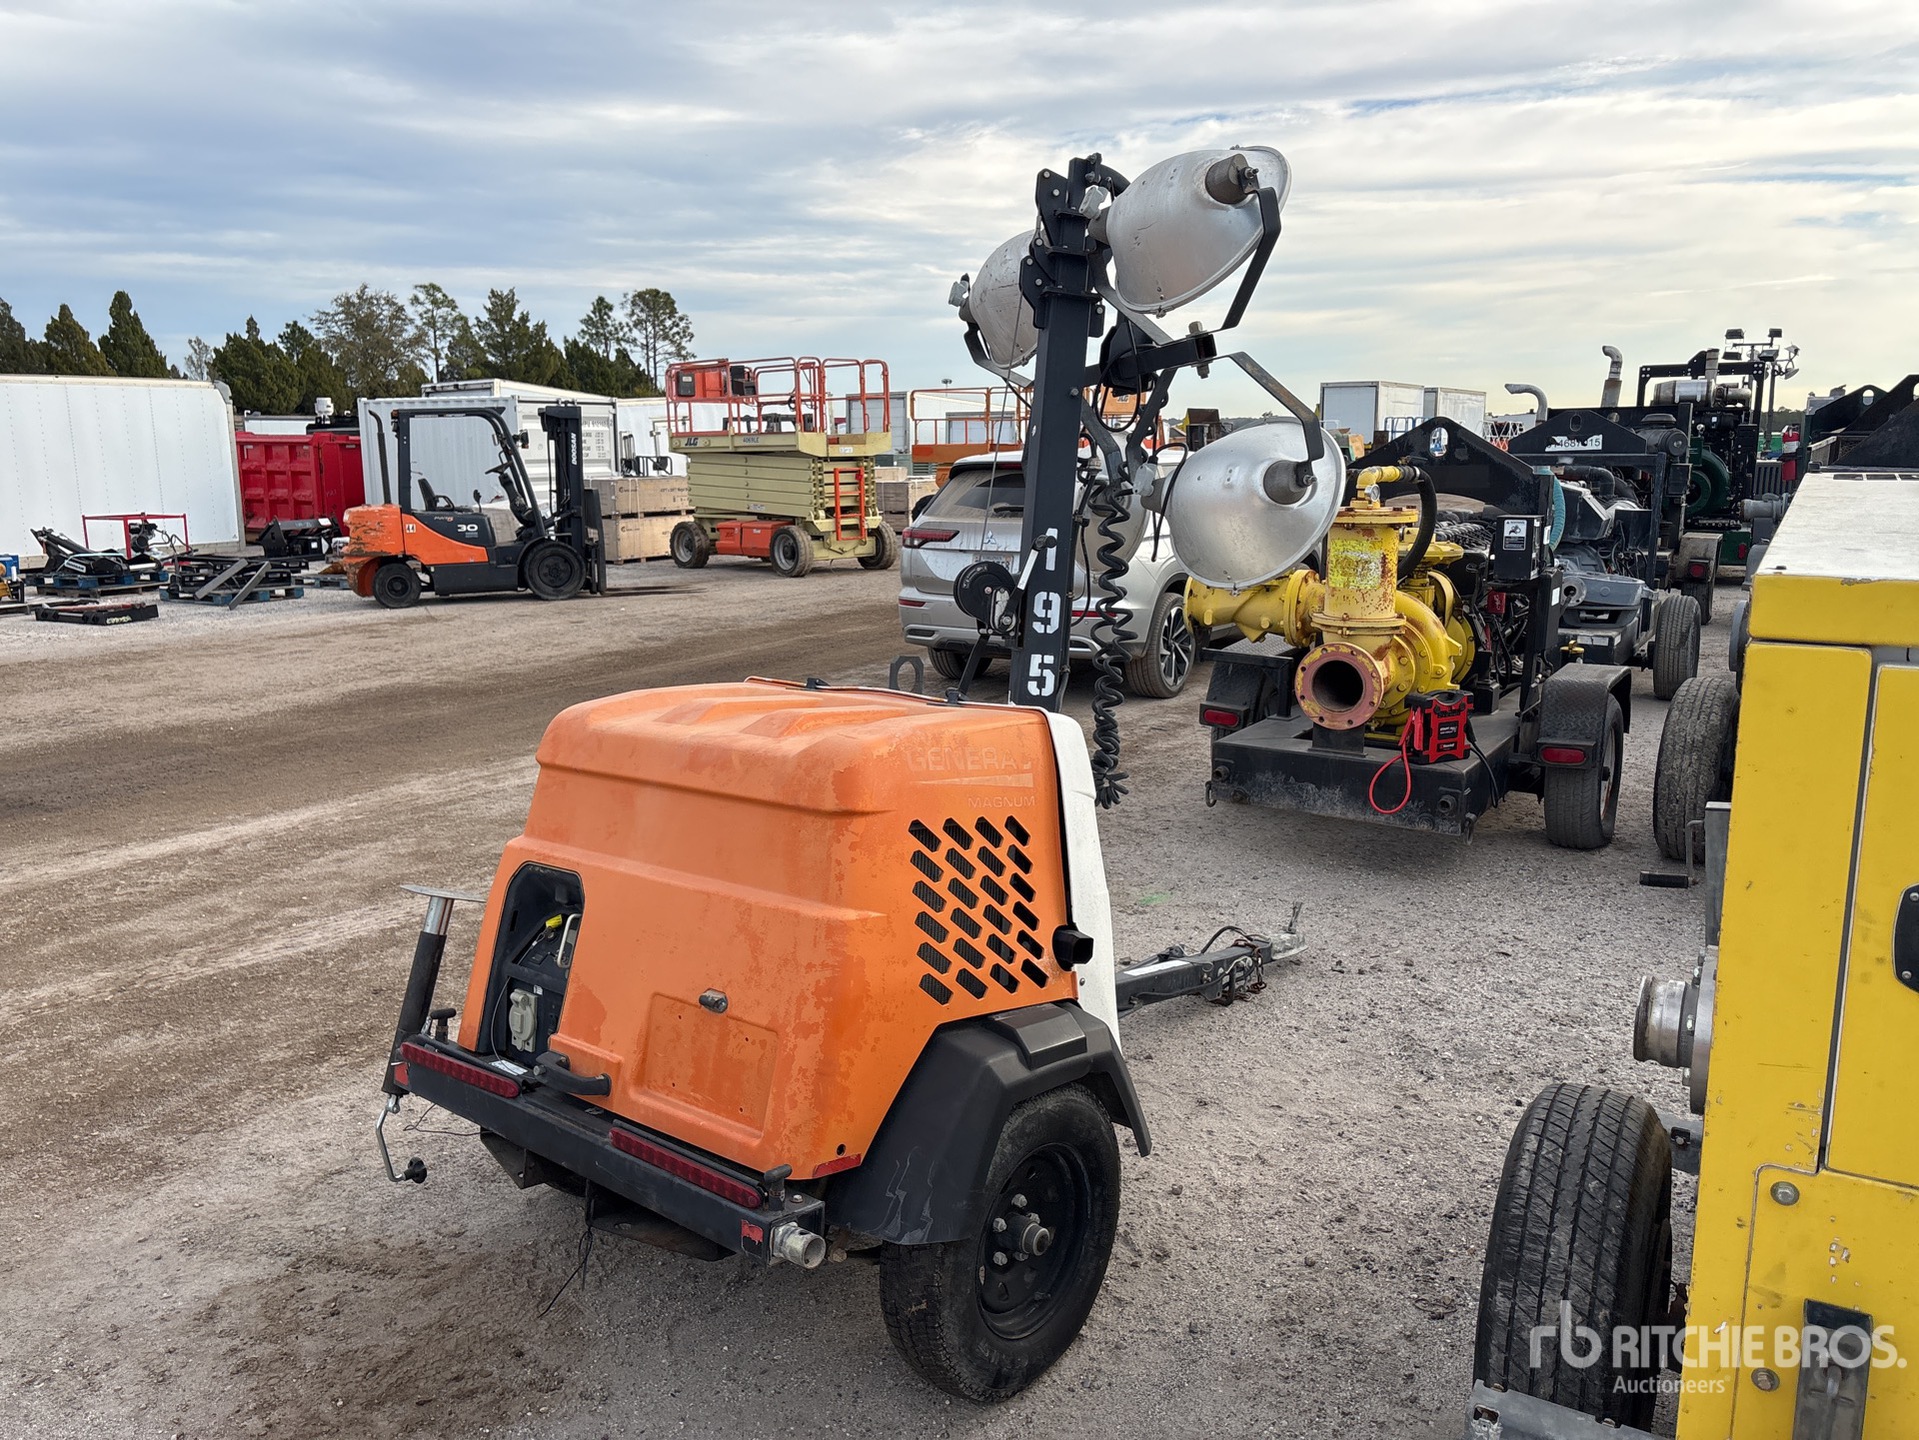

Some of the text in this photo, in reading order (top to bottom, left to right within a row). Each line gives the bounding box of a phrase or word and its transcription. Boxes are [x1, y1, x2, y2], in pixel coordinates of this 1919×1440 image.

[570, 432, 578, 466] DOOSAN
[685, 437, 699, 447] JLG
[457, 523, 479, 532] 30
[907, 746, 1033, 772] GENERA
[967, 795, 1036, 809] MAGNUM
